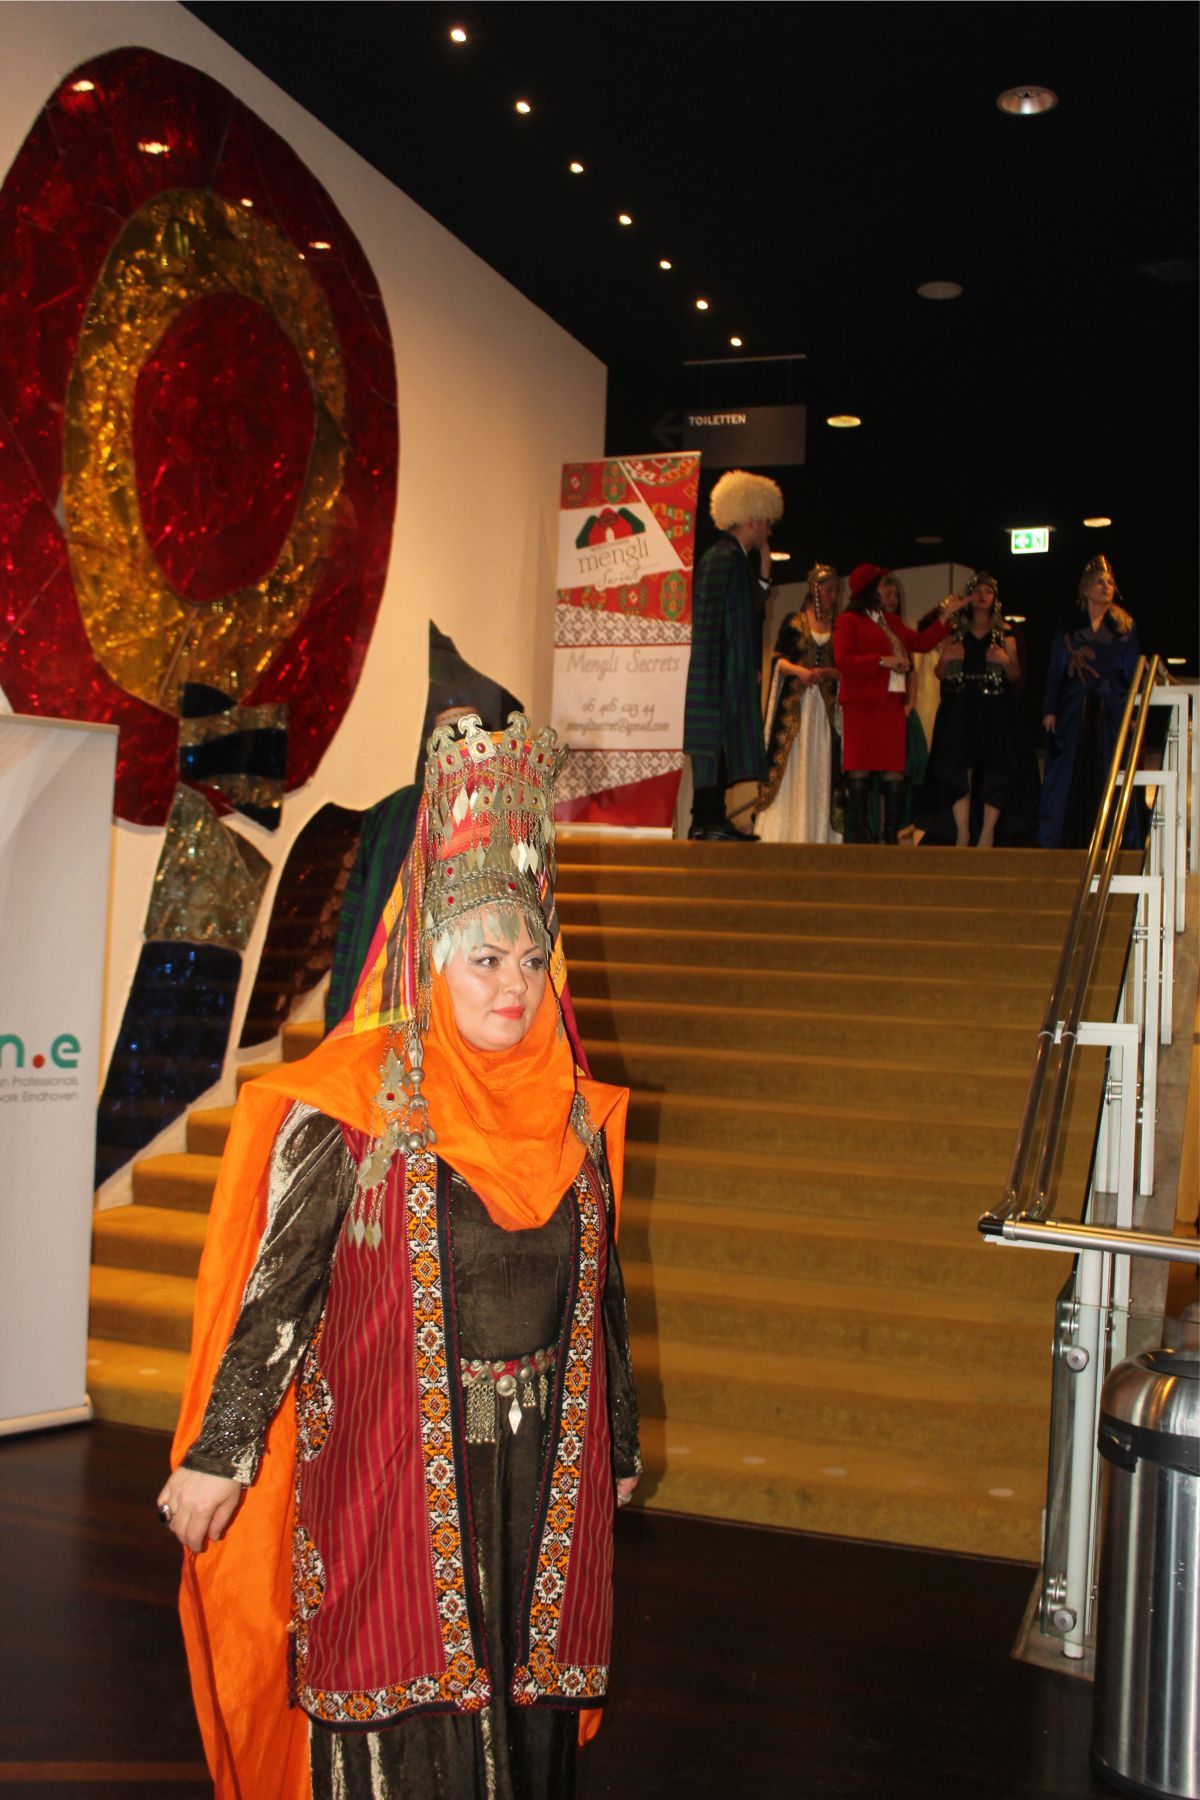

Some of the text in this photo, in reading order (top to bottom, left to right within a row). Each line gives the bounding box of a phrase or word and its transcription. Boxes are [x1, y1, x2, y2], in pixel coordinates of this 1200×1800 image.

[688, 413, 747, 426] TOILETTEN
[578, 536, 650, 573] mengli
[566, 648, 681, 681] Mengli Secrets
[22, 1091, 79, 1103] Eindhoven
